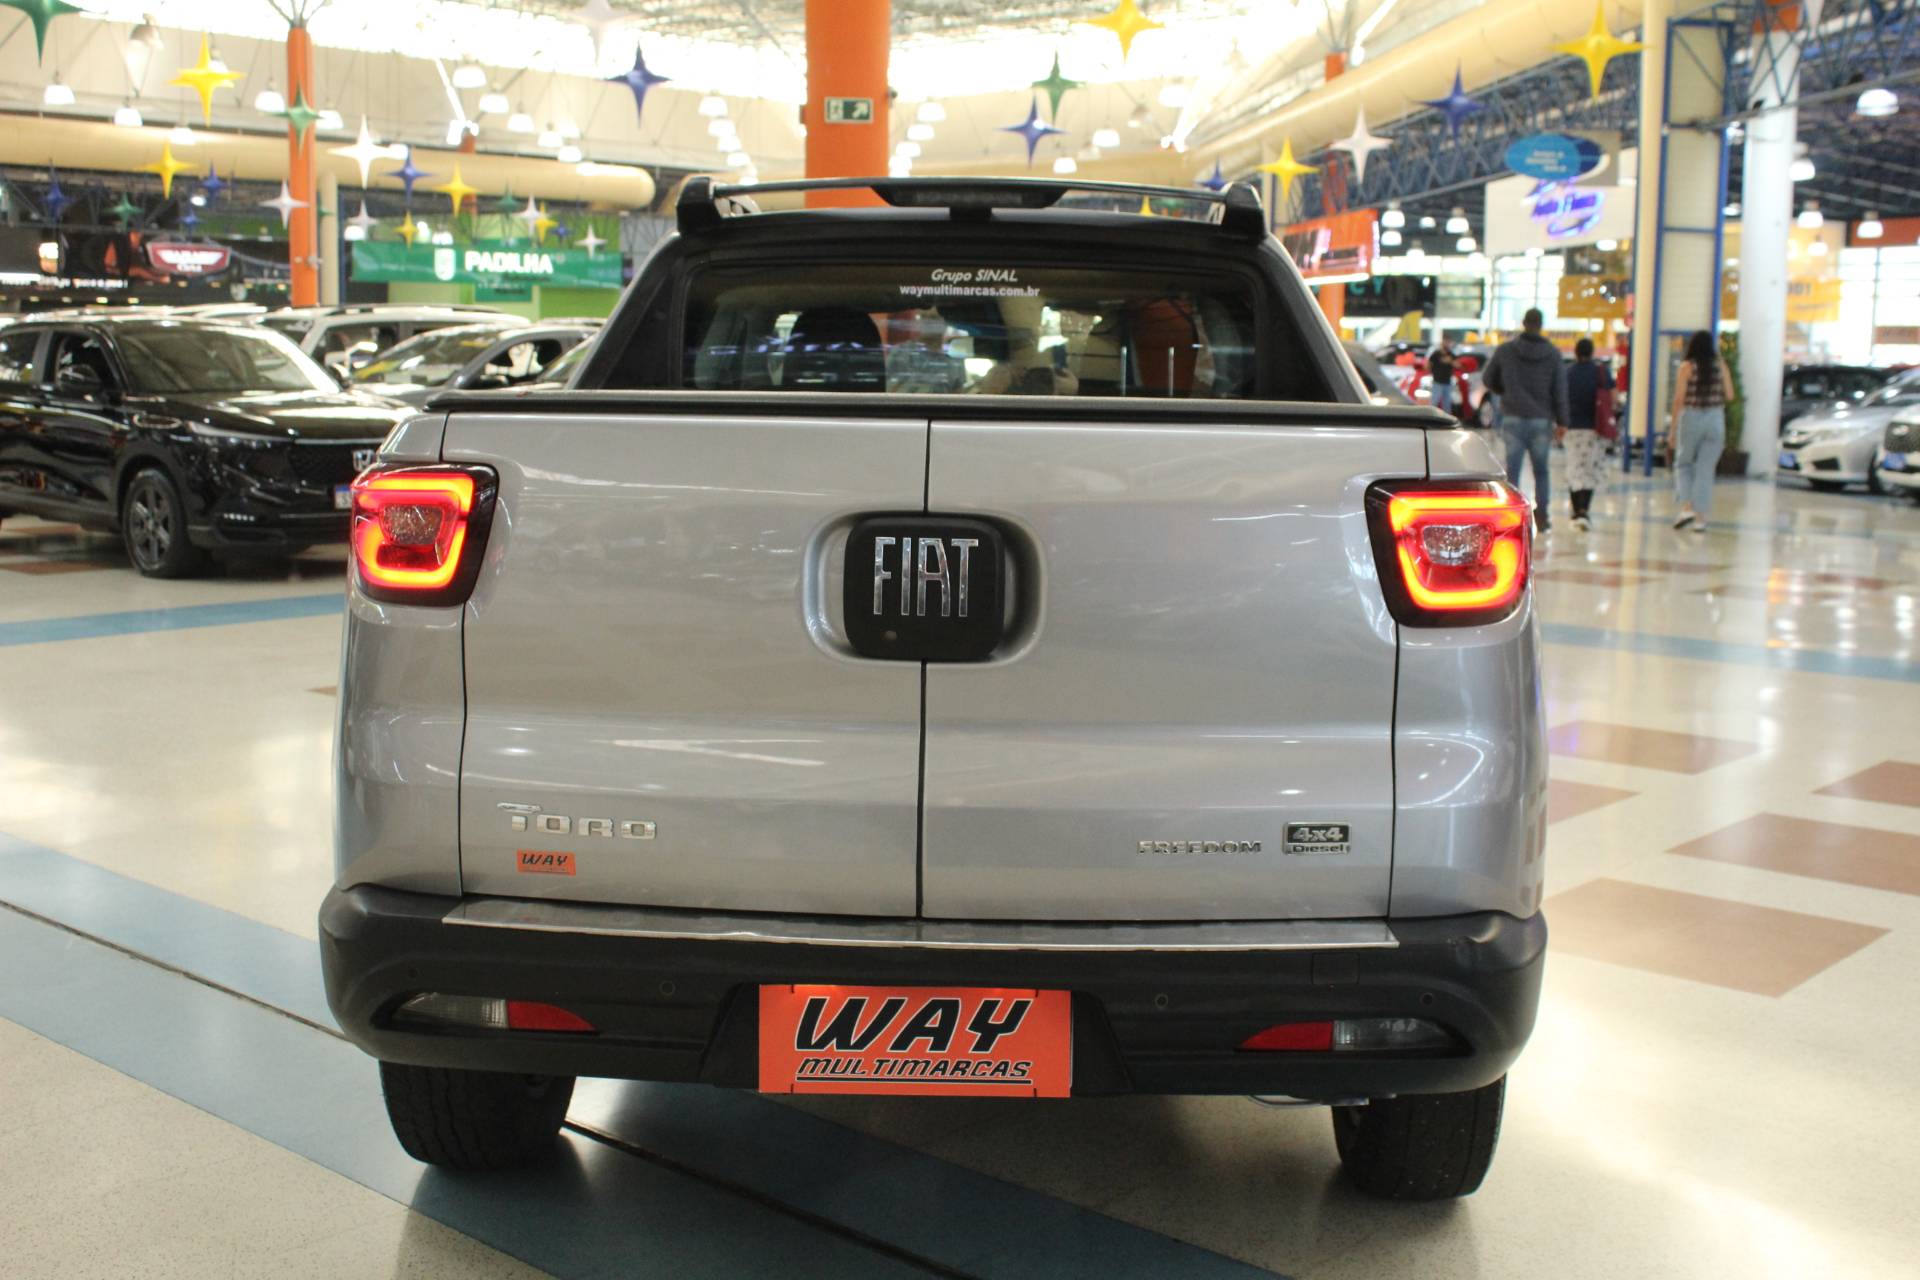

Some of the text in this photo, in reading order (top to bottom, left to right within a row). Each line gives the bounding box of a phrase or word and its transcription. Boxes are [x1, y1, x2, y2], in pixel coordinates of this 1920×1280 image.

[465, 250, 553, 274] PADILHA
[931, 268, 1018, 284] Grupo SINAL
[900, 284, 1040, 297] waymultimarcas.com.br
[873, 536, 979, 617] FIAT
[497, 802, 657, 840] TORO
[1292, 826, 1344, 841] 4x4
[1137, 840, 1262, 855] FREEDOM
[1292, 844, 1345, 853] Diesel
[522, 853, 567, 865] WAY
[795, 996, 1033, 1053] WAY
[796, 1057, 1033, 1078] MULTIMARCAS
